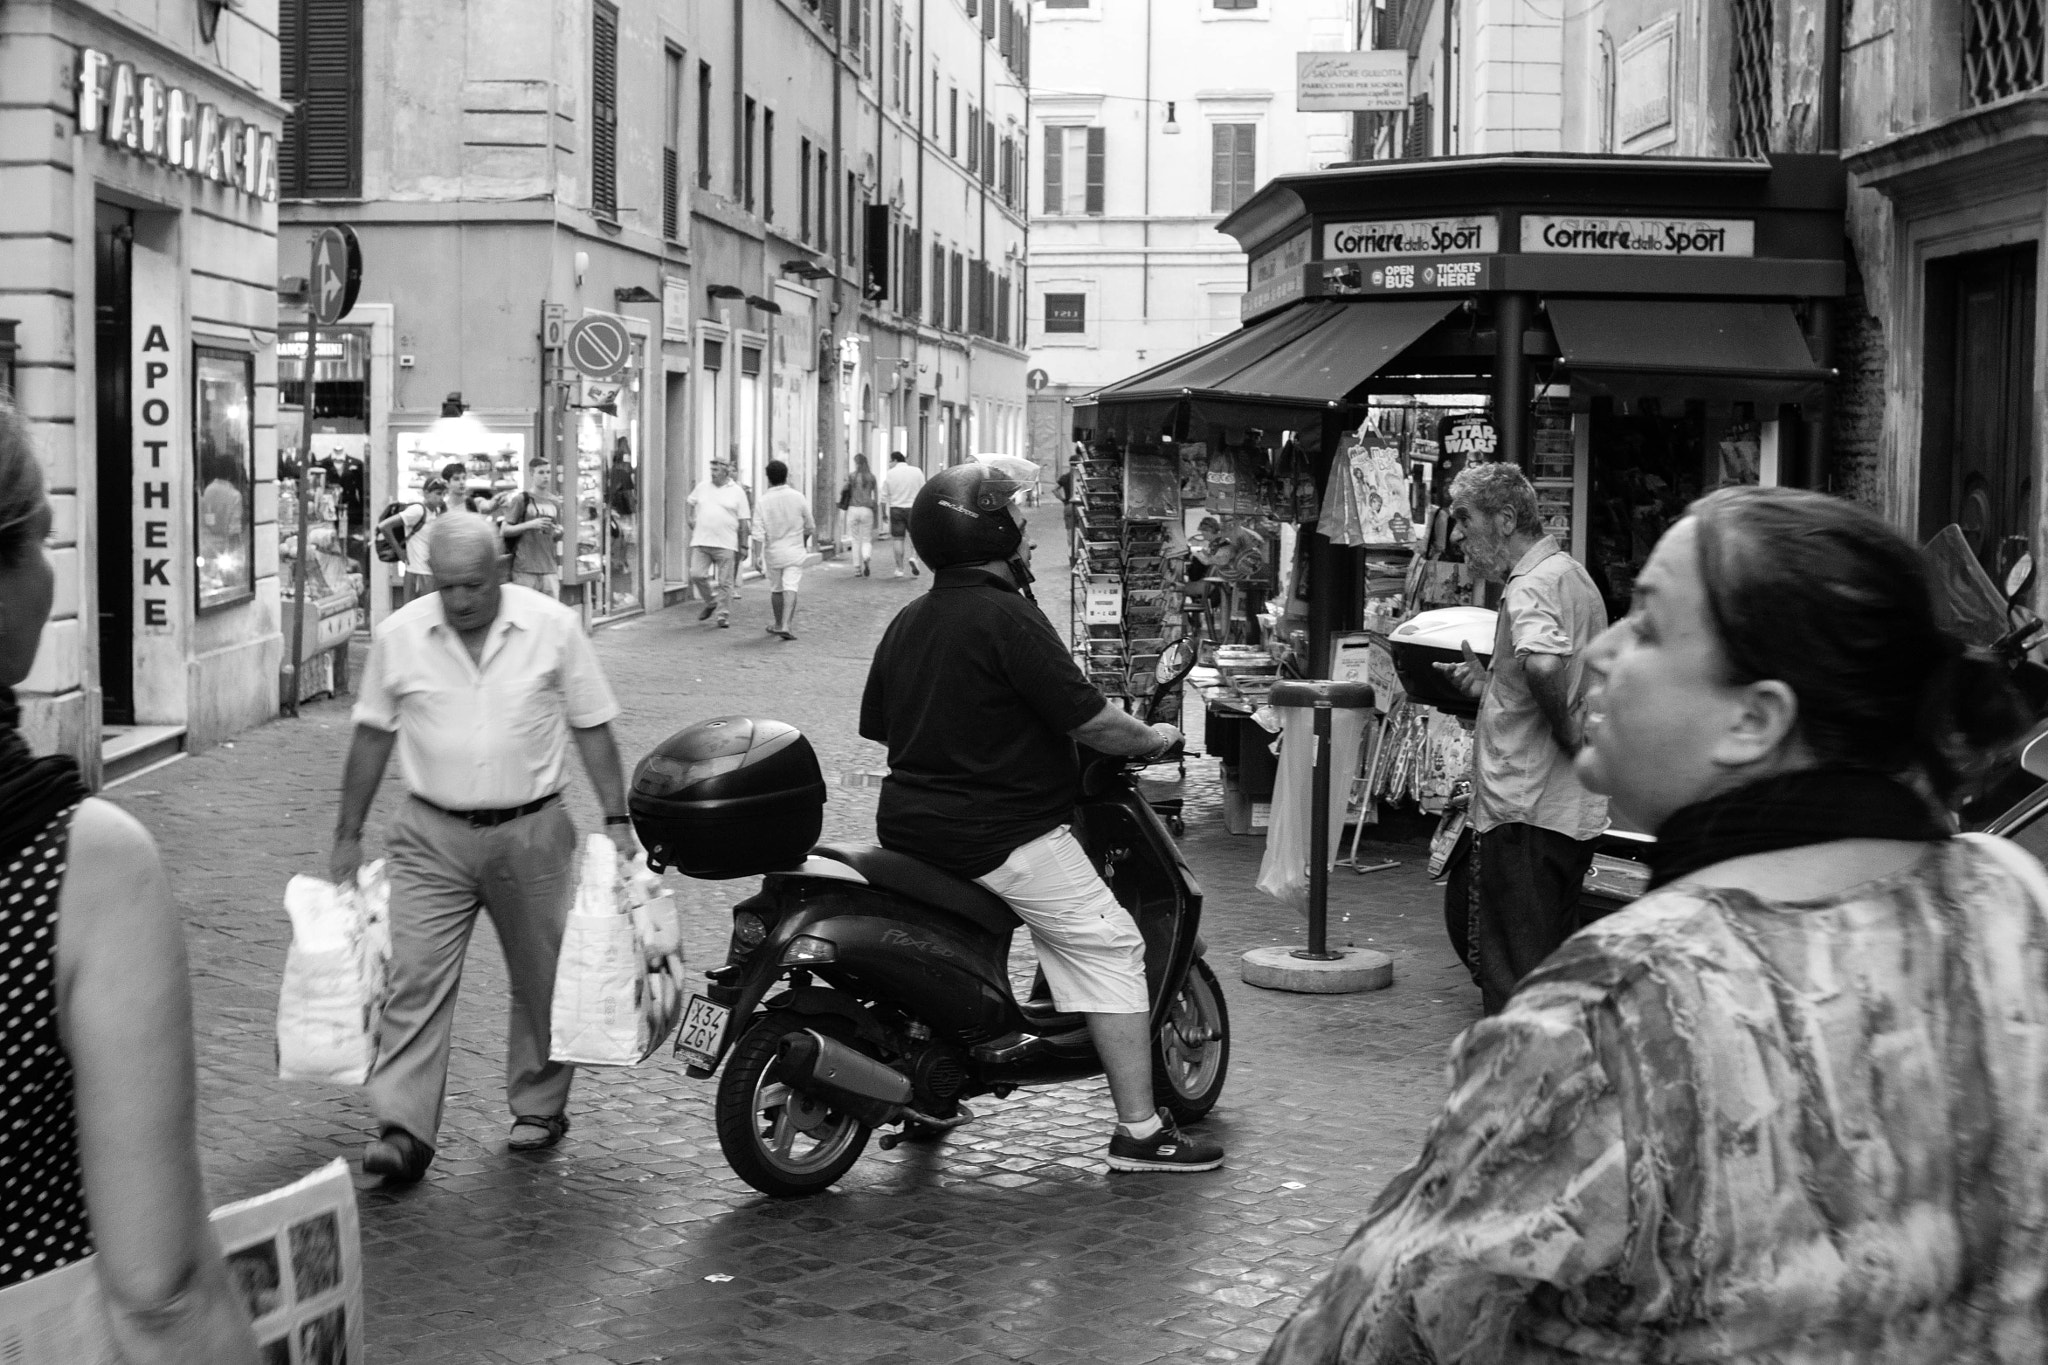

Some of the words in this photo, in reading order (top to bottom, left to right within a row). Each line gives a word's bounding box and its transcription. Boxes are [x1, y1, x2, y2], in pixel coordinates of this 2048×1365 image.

[79, 47, 277, 203] FARMACIA
[1334, 228, 1403, 254] Corriere
[1403, 235, 1430, 251] dello
[1430, 225, 1482, 254] Sport
[1543, 223, 1631, 250] Corriere
[1631, 234, 1663, 251] dello
[1664, 226, 1726, 255] Sport
[1385, 264, 1415, 276] OPEN
[1436, 262, 1482, 274] TICKETS
[1385, 274, 1415, 289] BUS
[1436, 272, 1476, 287] HERE
[1444, 424, 1497, 440] STAR
[1444, 438, 1498, 454] WARS
[141, 324, 171, 627] APOTHEKE
[691, 1002, 724, 1031] X34
[683, 1023, 717, 1052] ZGY
